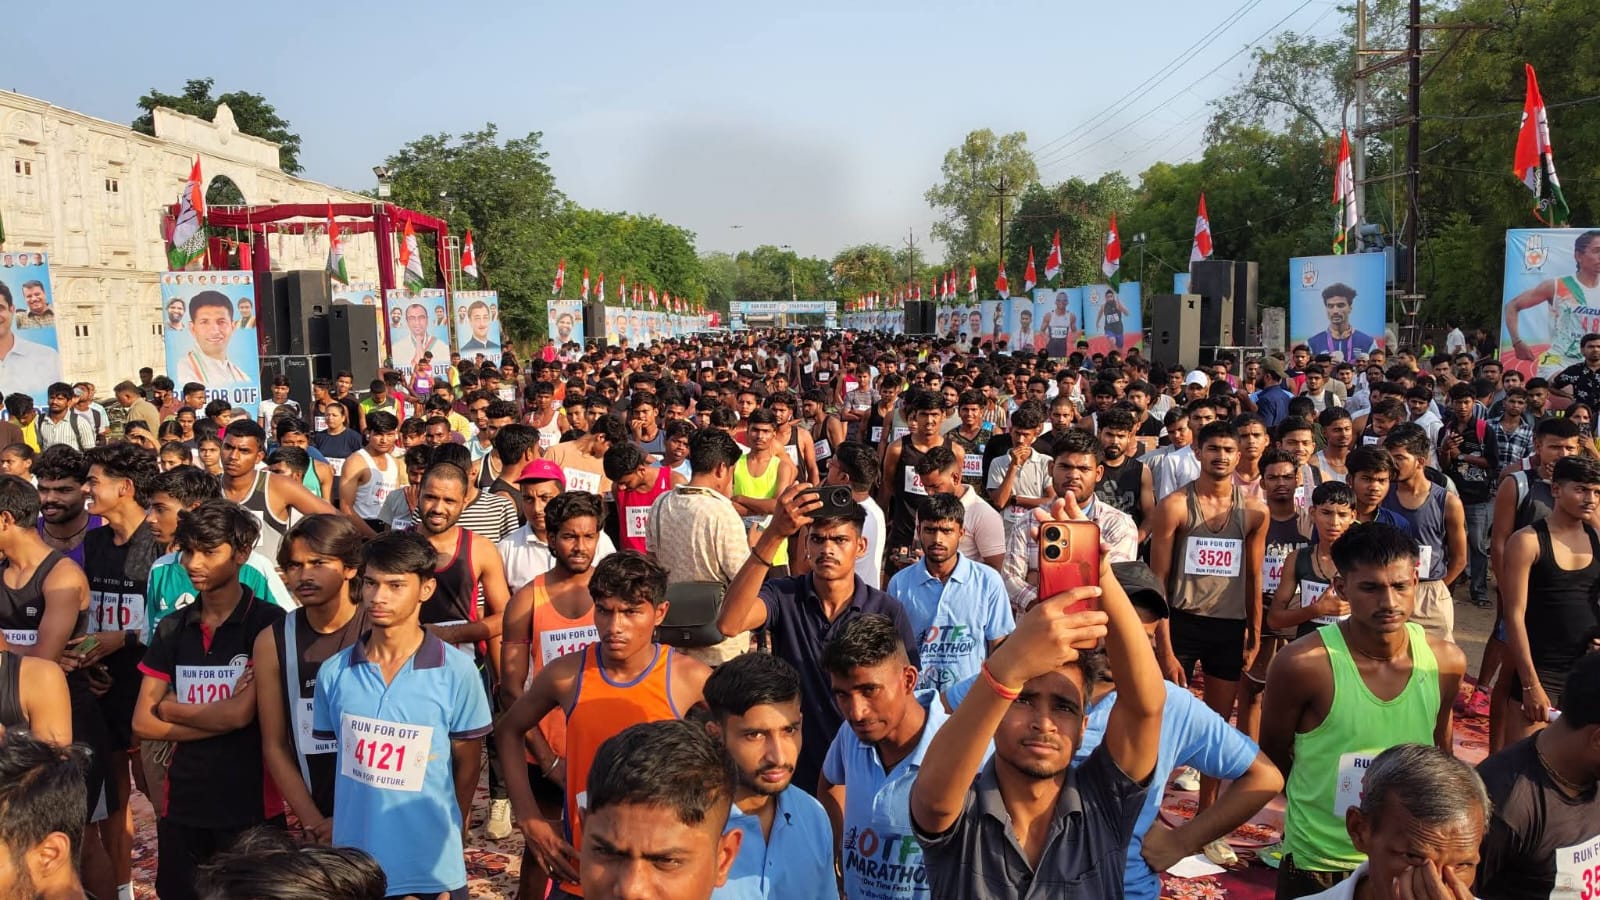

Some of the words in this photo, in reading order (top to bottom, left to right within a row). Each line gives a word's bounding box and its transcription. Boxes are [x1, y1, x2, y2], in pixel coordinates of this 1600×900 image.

[234, 388, 257, 403] OTF
[1198, 549, 1232, 566] 3520
[548, 633, 566, 642] RUN
[569, 630, 585, 640] FOR
[920, 642, 974, 654] ARATHON
[182, 670, 197, 678] RUN
[200, 670, 215, 678] FOR
[218, 670, 235, 678] OTF
[188, 684, 230, 704] 4120
[352, 720, 371, 732] RUN
[374, 724, 396, 737] FOR
[399, 728, 419, 740] OTF
[354, 738, 406, 772] 4121
[352, 768, 362, 777] RUN
[363, 772, 374, 782] FOR
[376, 776, 406, 786] FUTURE
[858, 827, 920, 865] OTF
[1574, 848, 1593, 864] RUN
[846, 850, 928, 885] MARATHO
